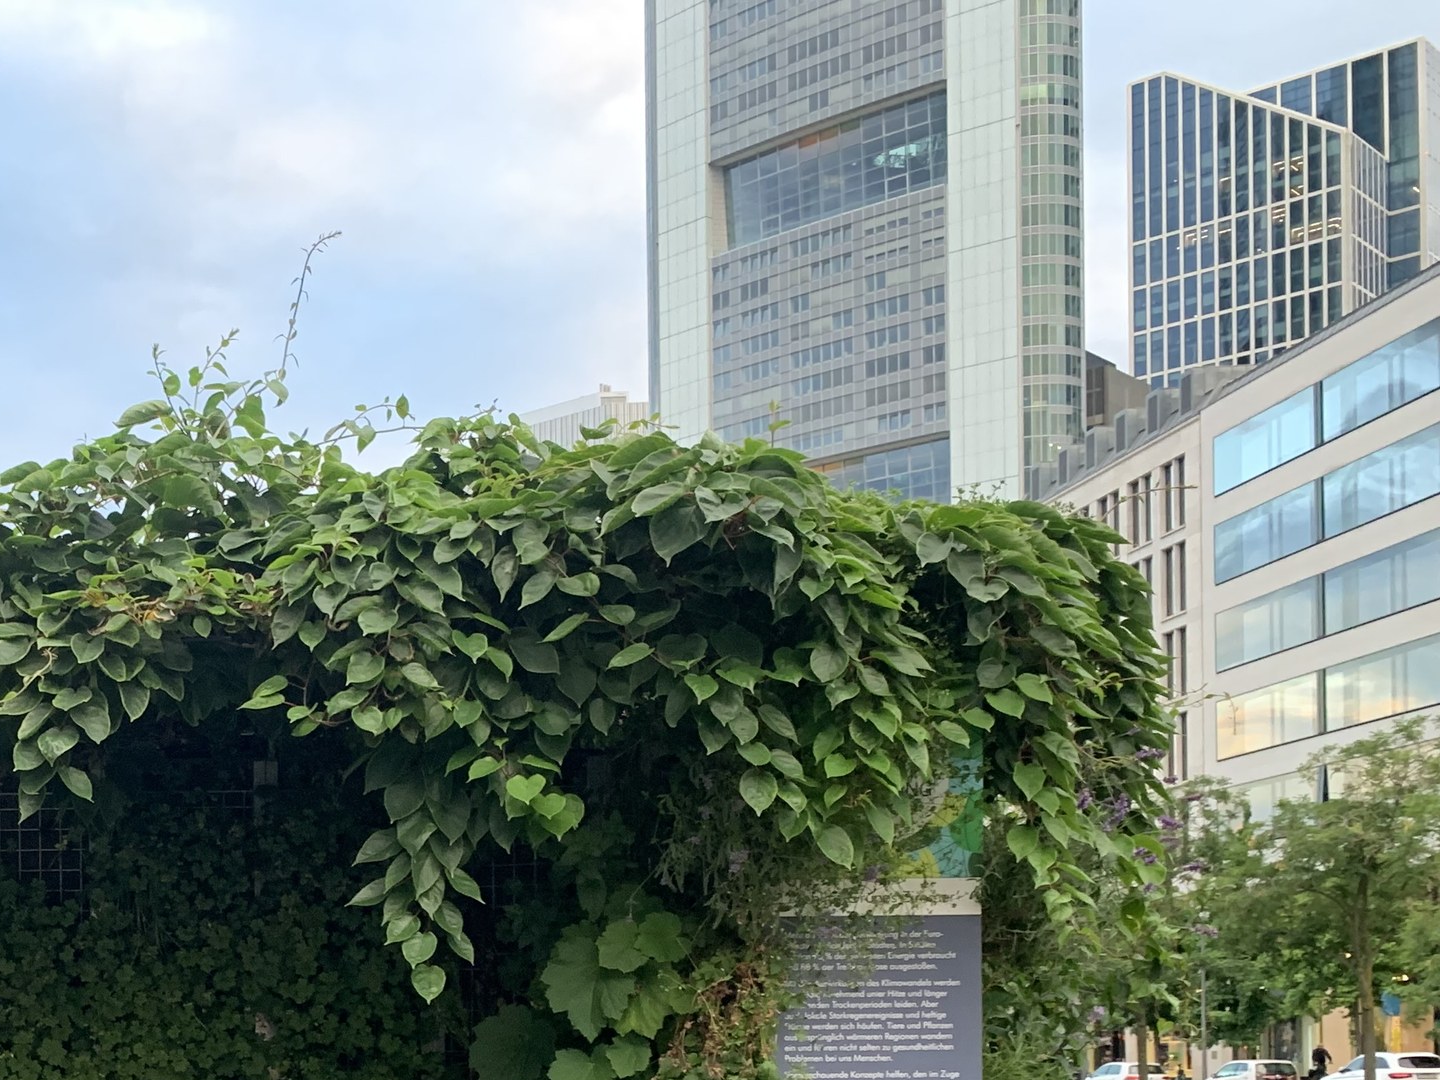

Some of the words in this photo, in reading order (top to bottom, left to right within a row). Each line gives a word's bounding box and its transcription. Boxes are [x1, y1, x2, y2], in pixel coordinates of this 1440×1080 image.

[812, 1022, 838, 1030] werden
[840, 1022, 855, 1030] sich
[907, 1021, 921, 1029] und
[923, 1021, 953, 1029] Pflanzen
[850, 1071, 884, 1080] Konzepte
[886, 1070, 911, 1079] helfen,
[913, 1070, 927, 1078] den
[940, 1070, 960, 1079] Zuge
